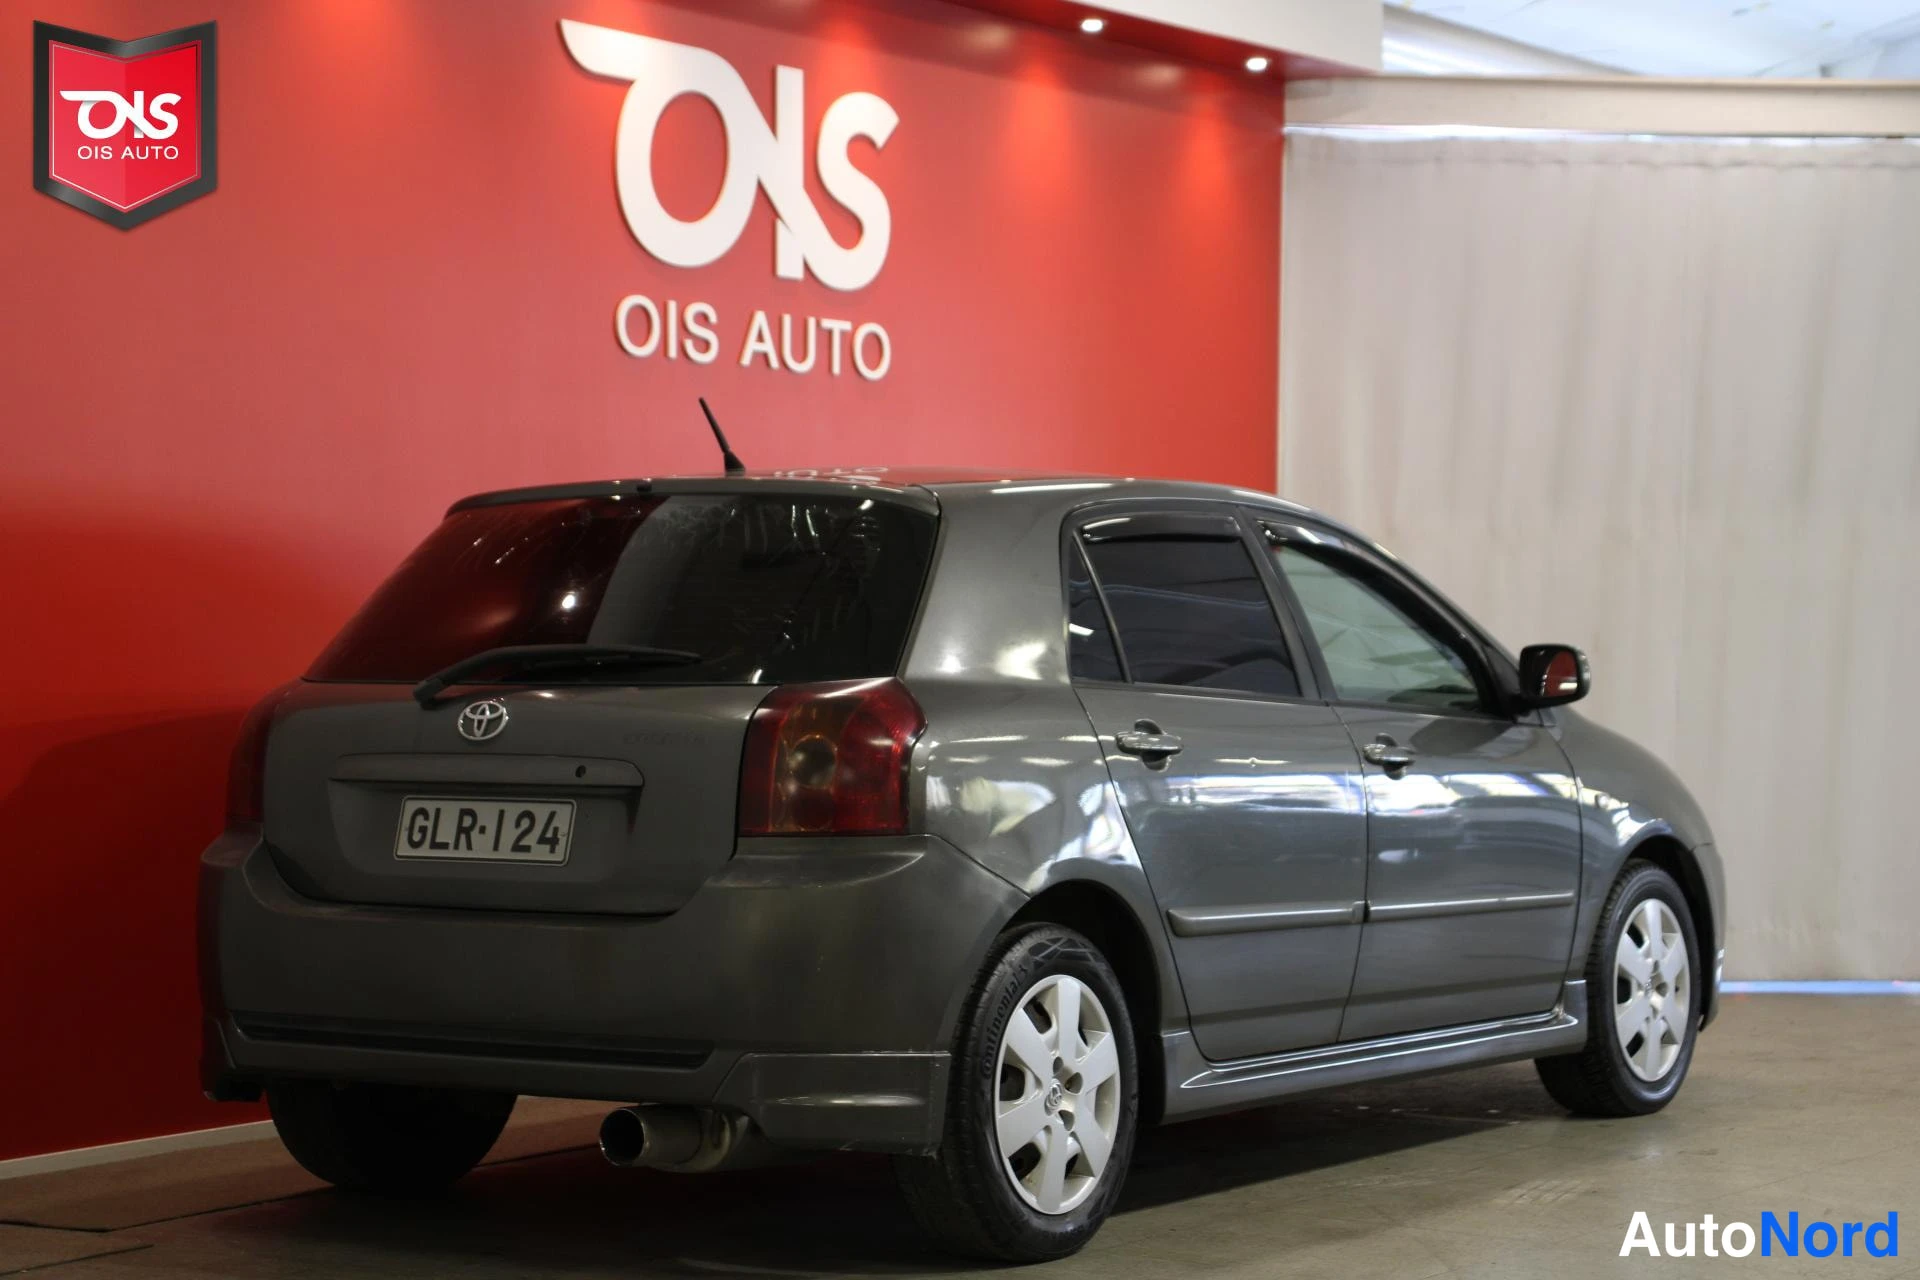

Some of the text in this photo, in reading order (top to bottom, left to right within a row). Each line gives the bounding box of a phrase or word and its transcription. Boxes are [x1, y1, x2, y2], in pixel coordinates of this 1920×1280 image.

[560, 18, 900, 291] OIS
[615, 294, 892, 381] OIS AUTO
